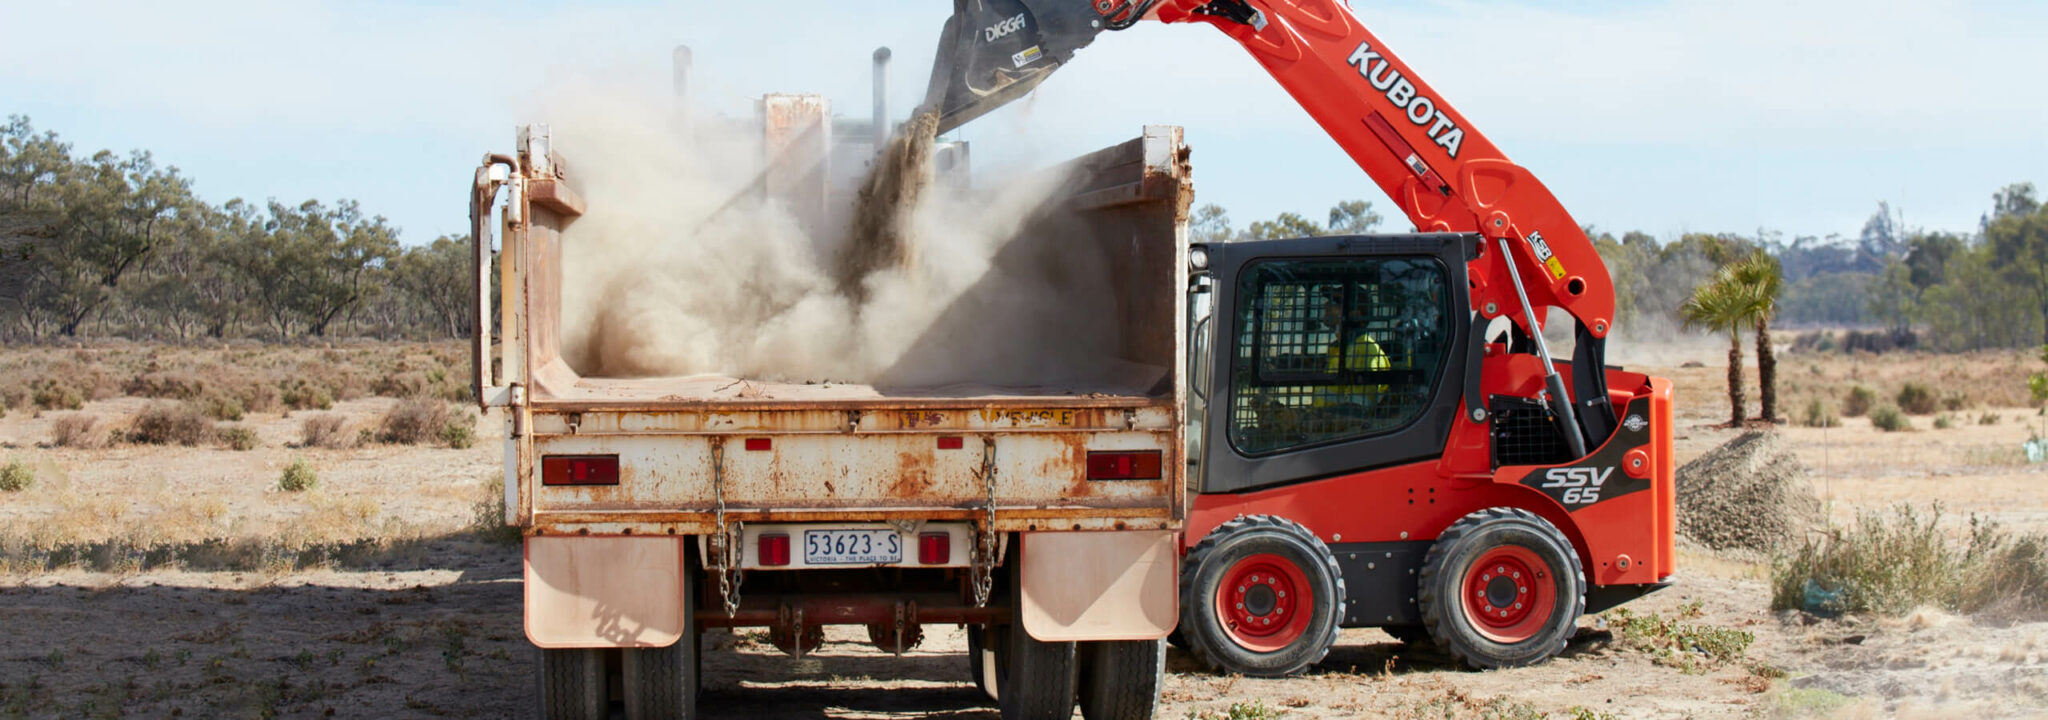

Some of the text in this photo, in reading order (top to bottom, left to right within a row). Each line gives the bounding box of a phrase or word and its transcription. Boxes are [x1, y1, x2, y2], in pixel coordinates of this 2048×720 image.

[985, 13, 1025, 42] DIGGA
[1347, 41, 1465, 159] KUBOTA
[1529, 230, 1552, 260] KSB
[1542, 467, 1615, 487] SSV
[1562, 487, 1600, 504] 65
